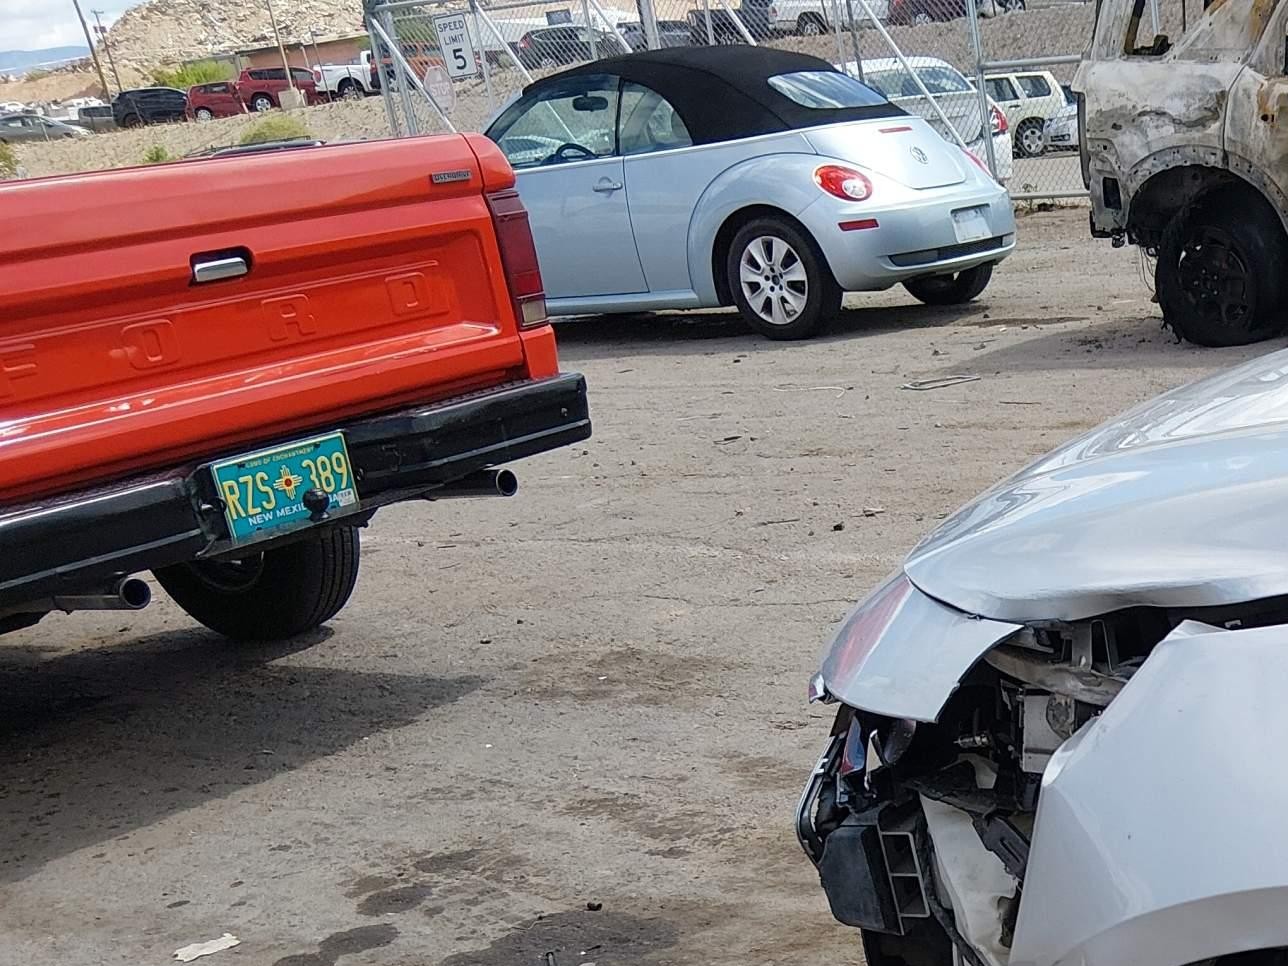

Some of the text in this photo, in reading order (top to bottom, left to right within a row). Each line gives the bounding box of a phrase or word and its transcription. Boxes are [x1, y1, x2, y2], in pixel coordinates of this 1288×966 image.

[437, 20, 464, 33] SPEED
[443, 34, 464, 46] LIMIT
[452, 48, 467, 70] 5
[222, 451, 348, 520] RZS 389
[248, 512, 274, 527] NEW
